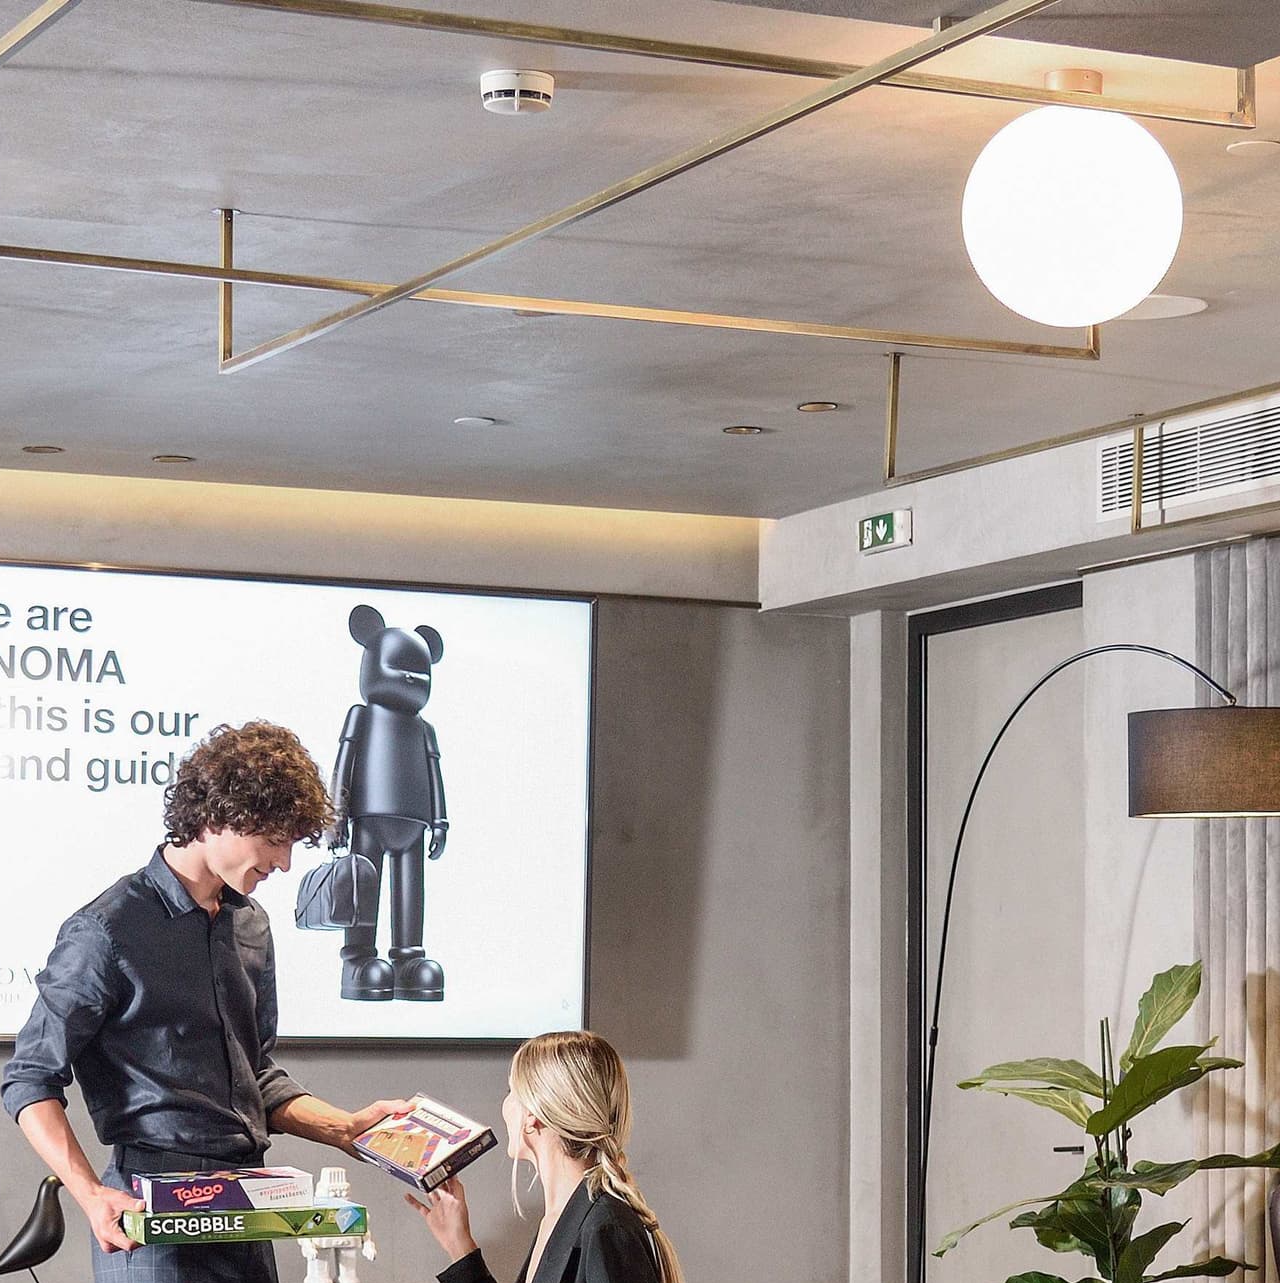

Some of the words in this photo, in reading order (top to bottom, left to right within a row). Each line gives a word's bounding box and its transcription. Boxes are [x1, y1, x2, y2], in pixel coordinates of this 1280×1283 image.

[26, 604, 93, 633] are
[83, 698, 115, 735] is
[130, 709, 200, 737] our
[86, 751, 176, 792] guid
[172, 1184, 224, 1202] Taboo
[150, 1215, 245, 1236] SCRABBLE
